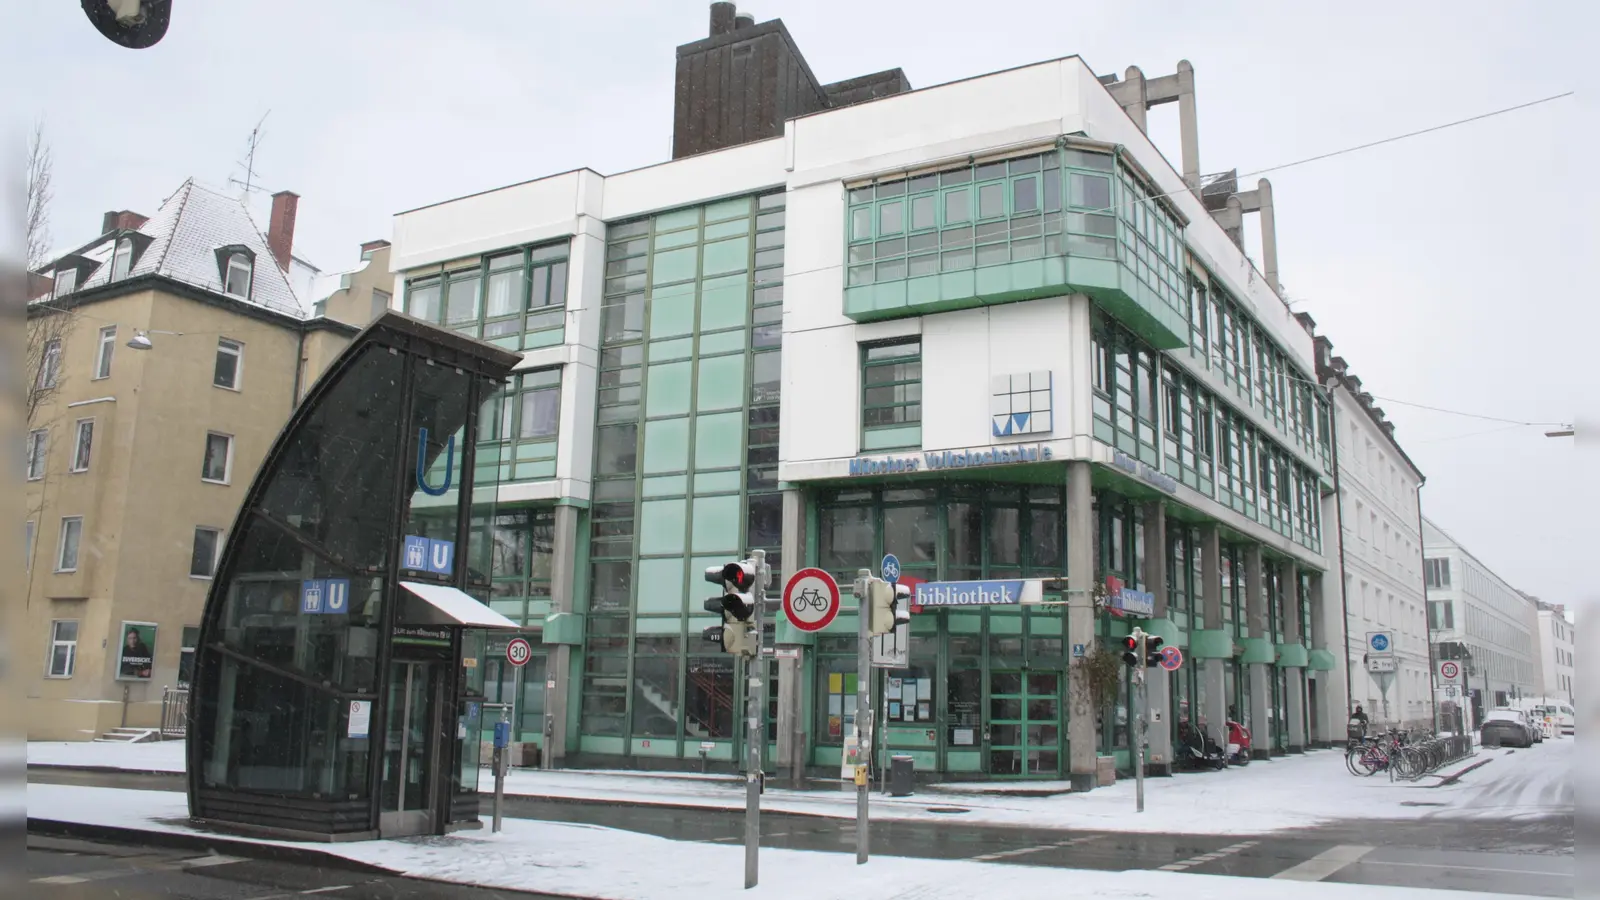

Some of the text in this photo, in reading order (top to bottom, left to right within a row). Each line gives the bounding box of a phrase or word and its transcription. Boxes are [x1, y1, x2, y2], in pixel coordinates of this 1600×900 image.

[416, 427, 455, 496] U
[433, 543, 448, 569] U
[329, 583, 345, 609] U
[917, 585, 1013, 605] bibliothek
[511, 645, 526, 659] 30
[1444, 666, 1455, 675] 30
